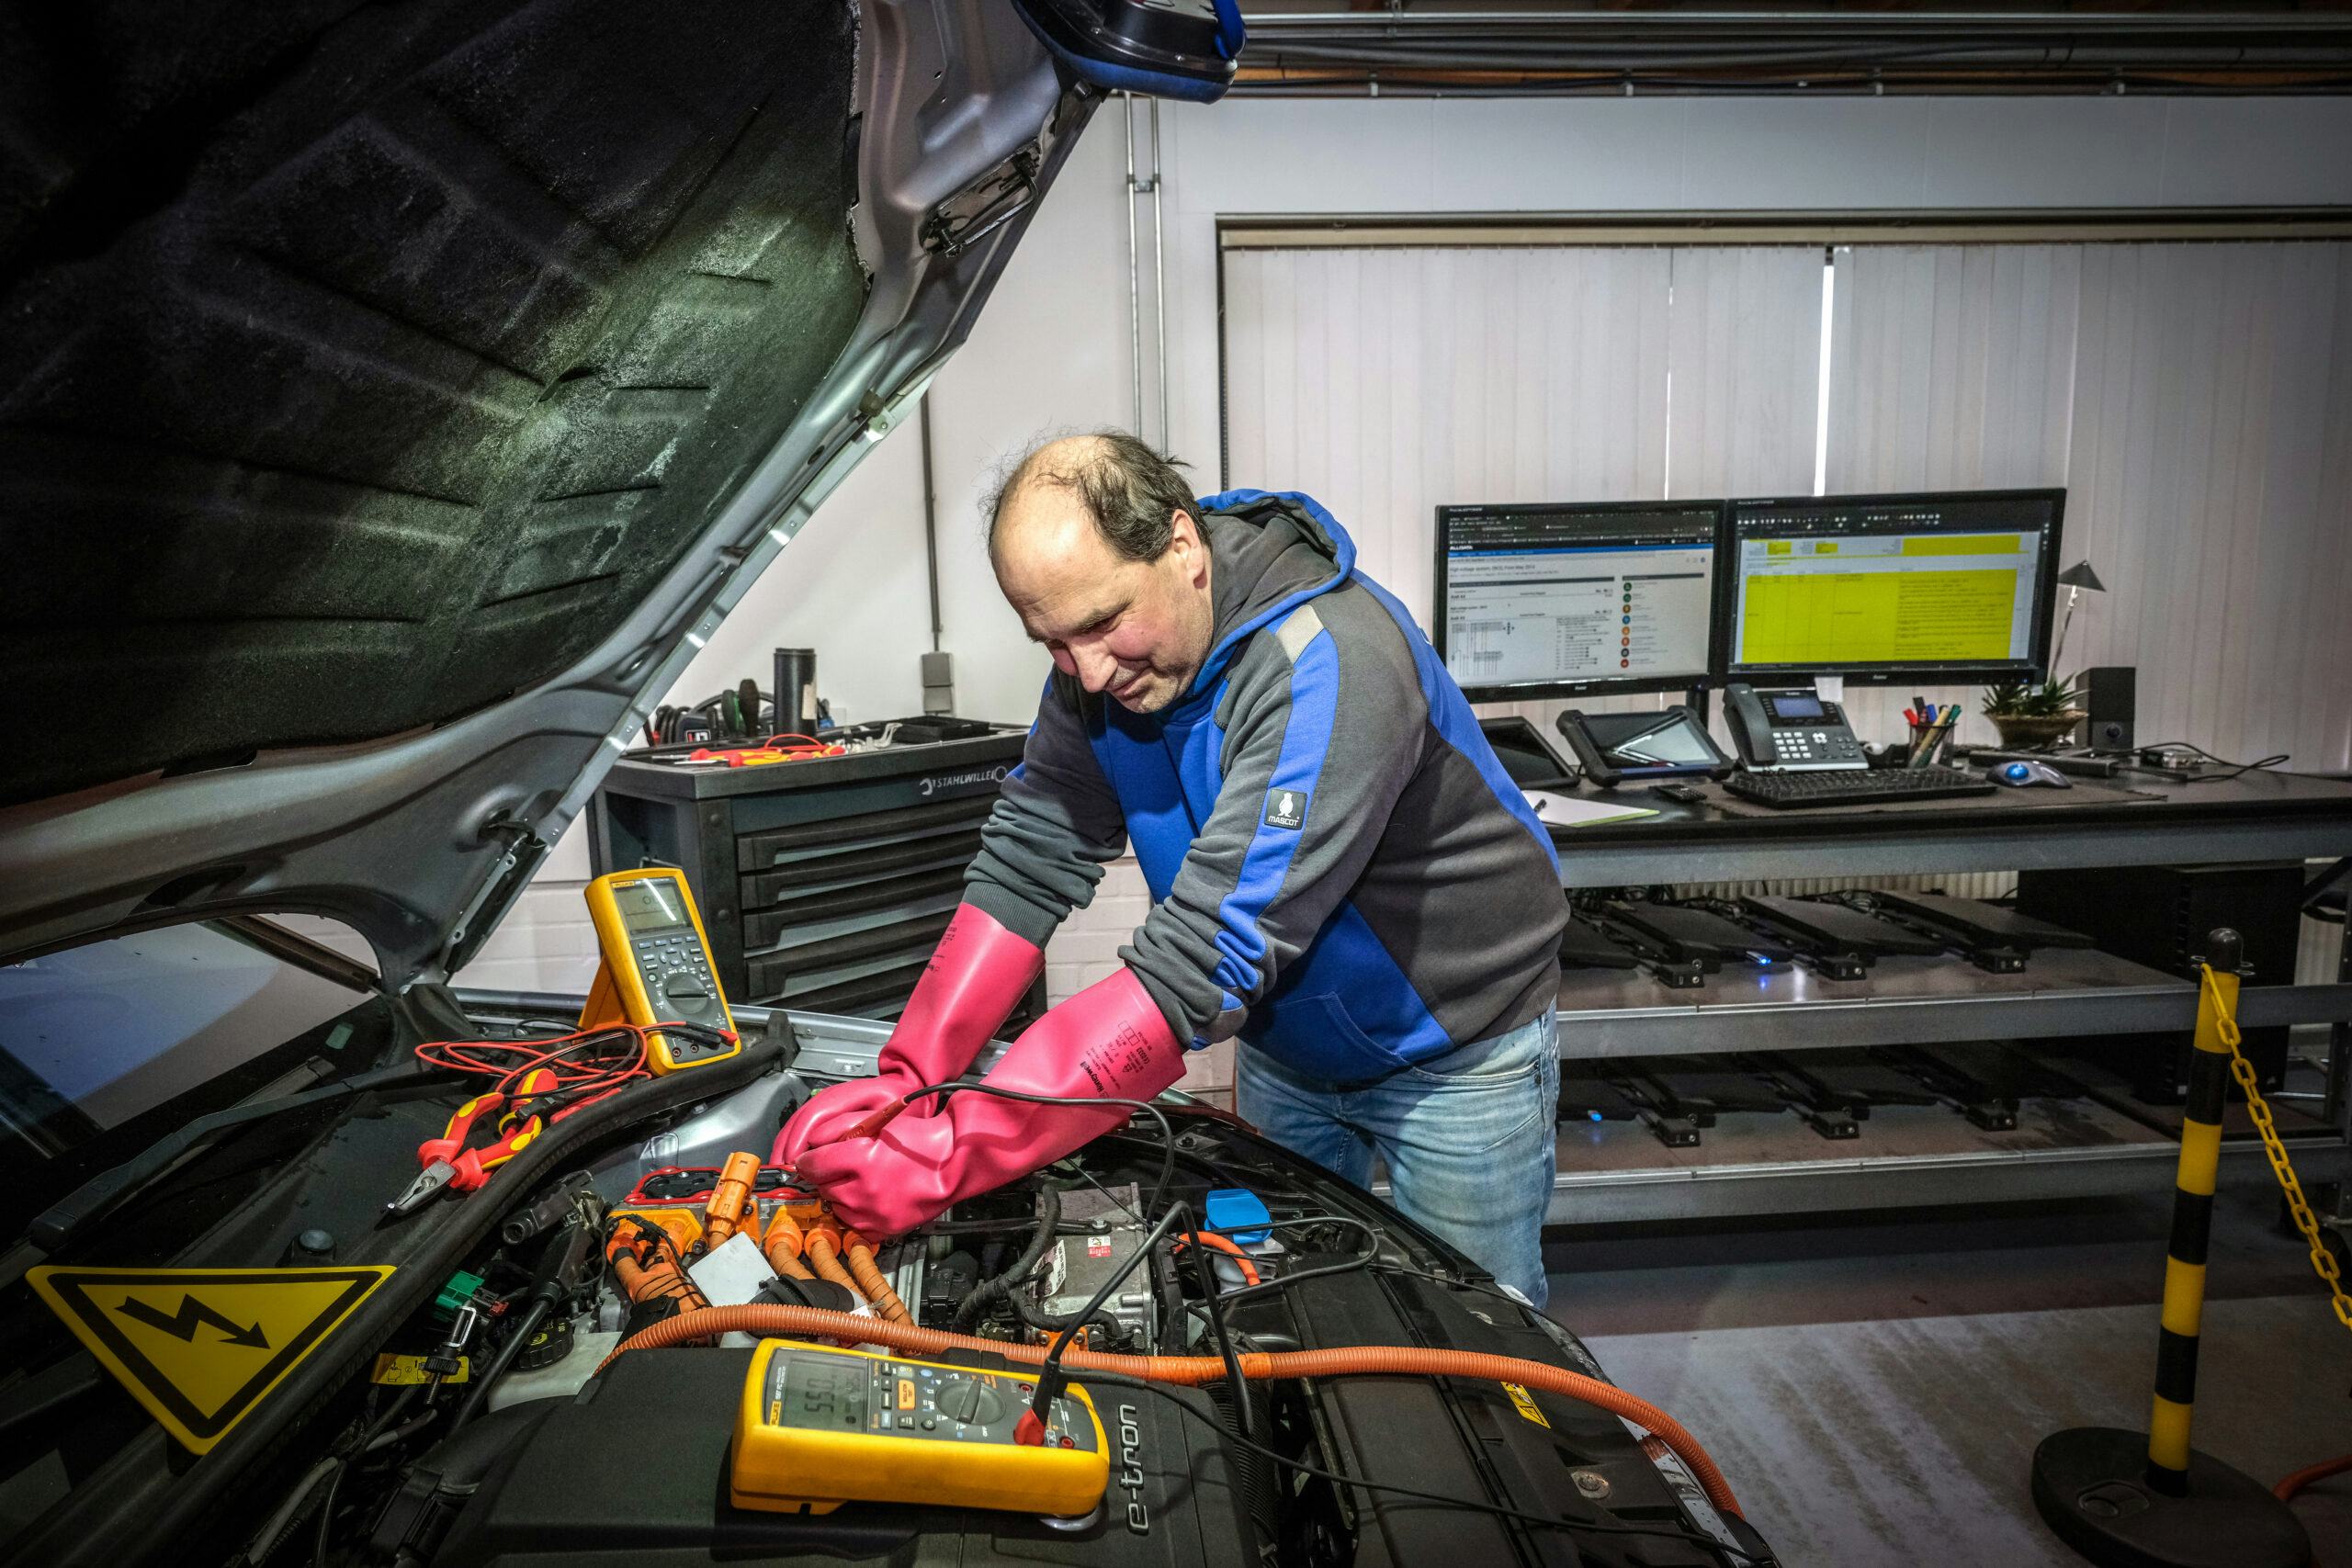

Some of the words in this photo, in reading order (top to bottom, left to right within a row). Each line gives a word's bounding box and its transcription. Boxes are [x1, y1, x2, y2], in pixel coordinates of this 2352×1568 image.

[937, 771, 991, 787] STAHLWILLE
[1268, 816, 1298, 826] MASCOT
[1080, 1061, 1104, 1092] Honeywell
[1119, 1404, 1149, 1530] e-tron
